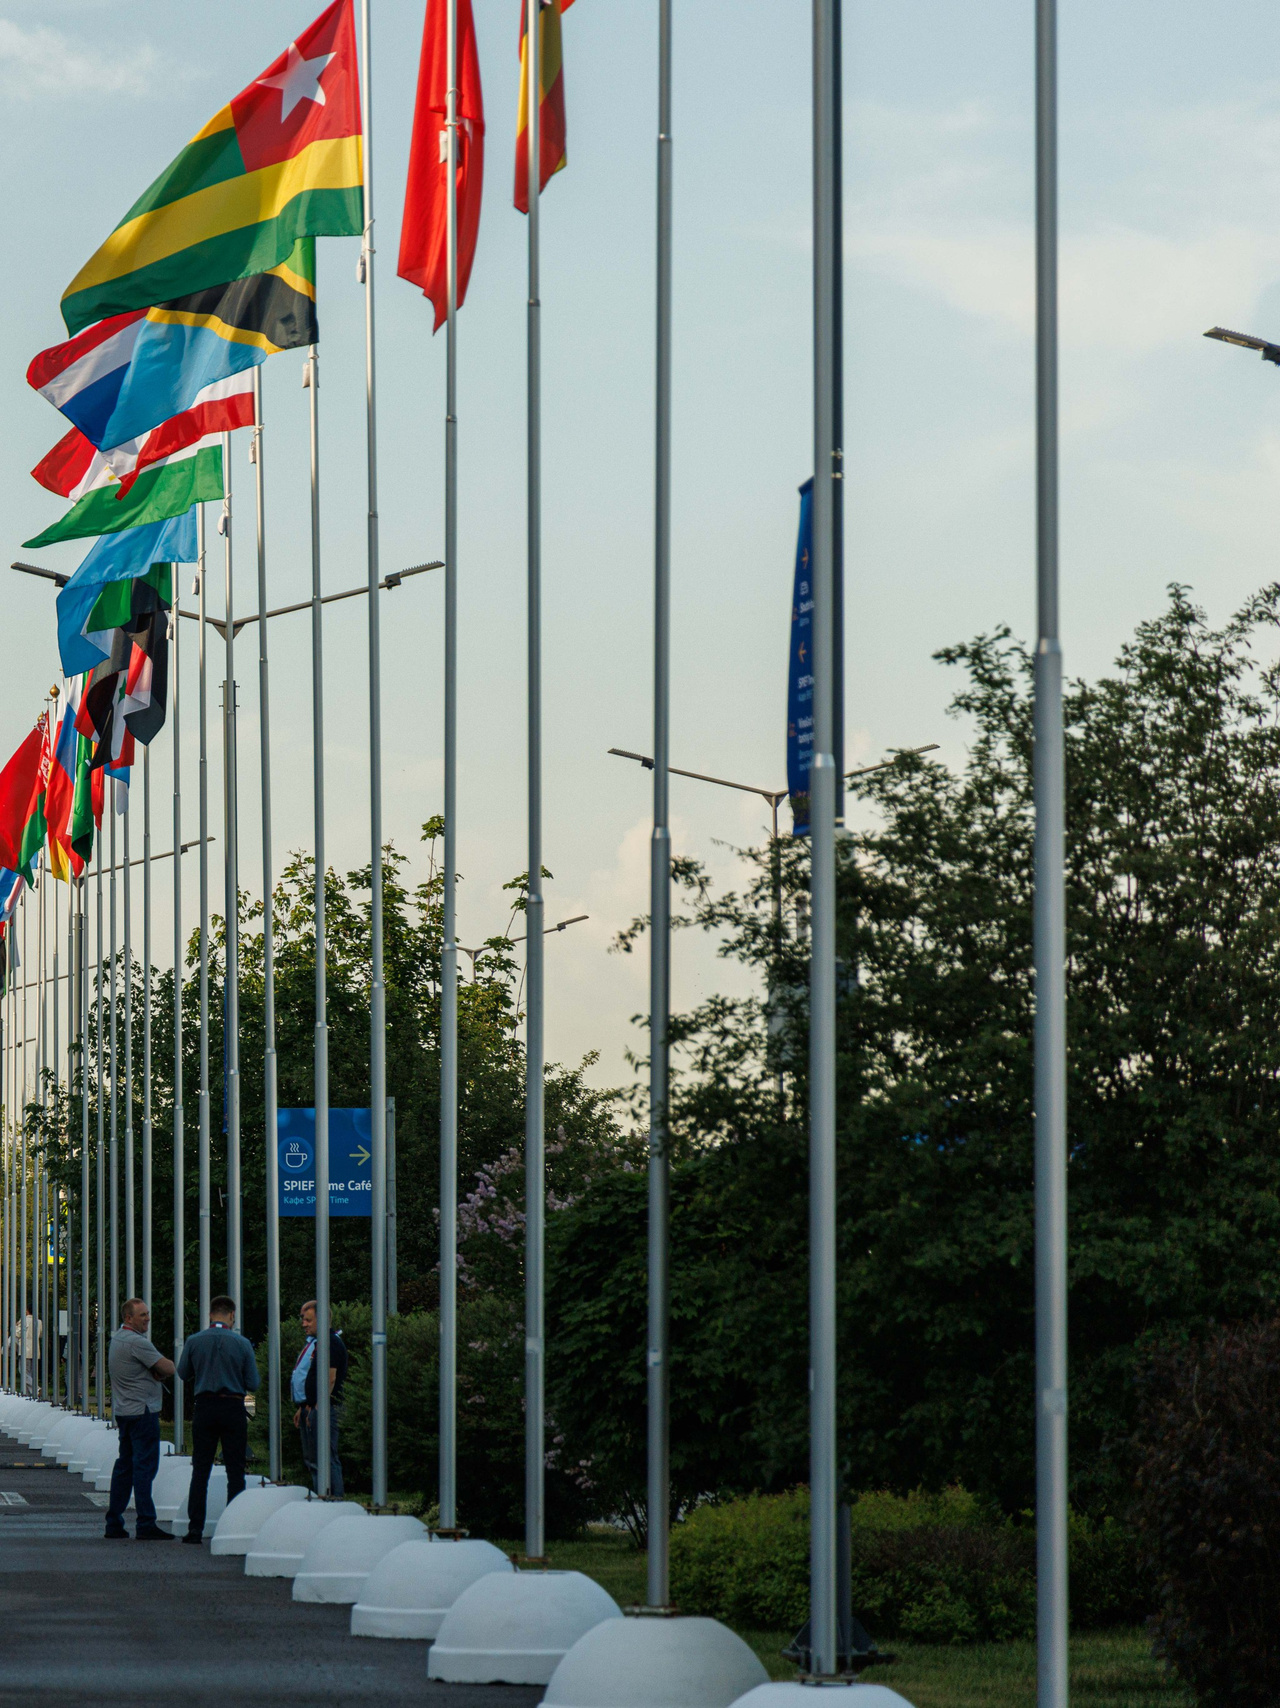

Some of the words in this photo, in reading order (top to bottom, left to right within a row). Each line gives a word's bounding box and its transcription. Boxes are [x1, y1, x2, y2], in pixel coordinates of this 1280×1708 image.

[283, 1180, 315, 1191] SPIEF
[328, 1182, 345, 1191] me
[348, 1180, 372, 1191] Café
[283, 1196, 304, 1205] Кафе
[330, 1196, 349, 1204] Time
